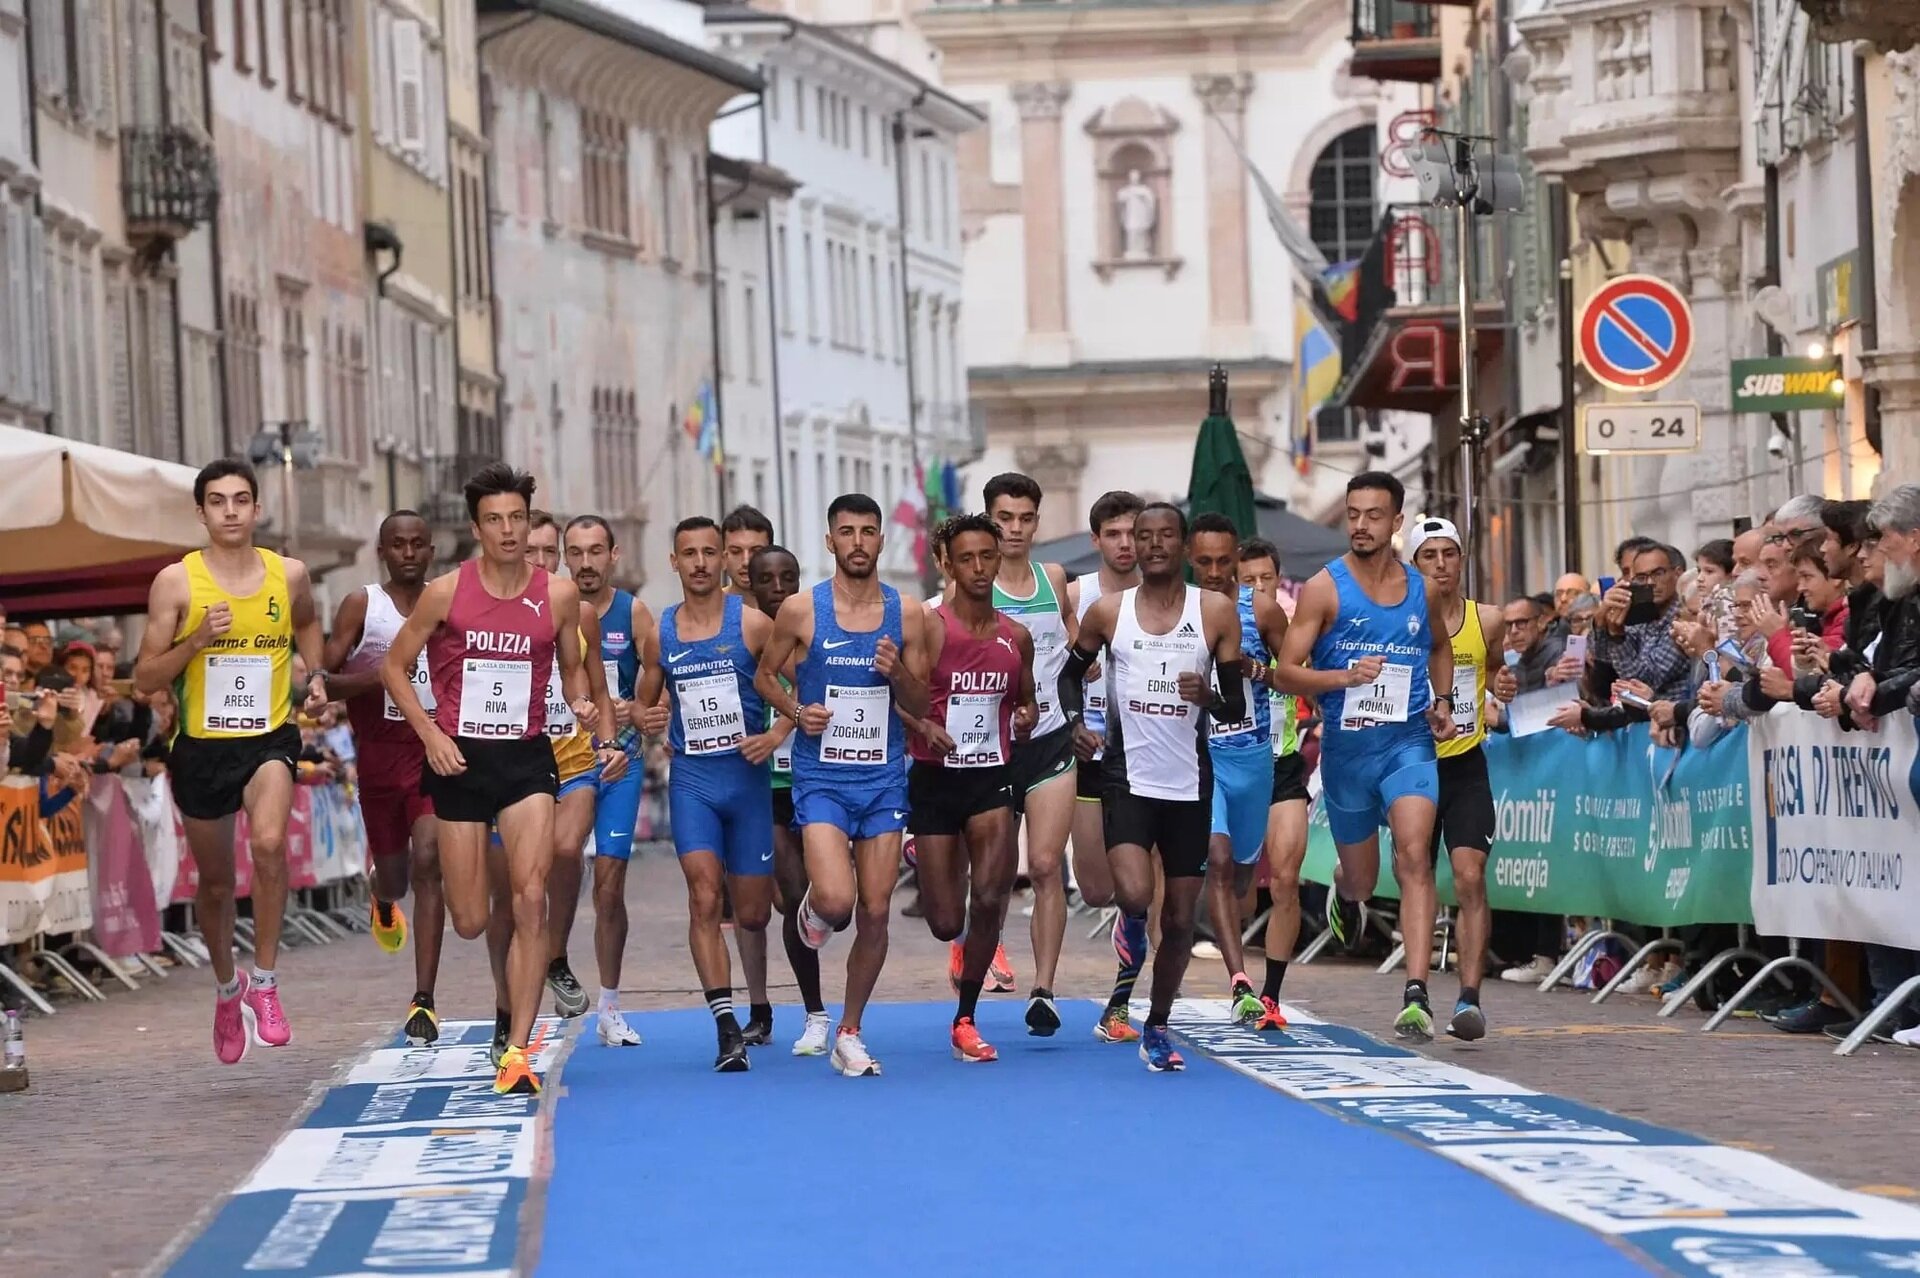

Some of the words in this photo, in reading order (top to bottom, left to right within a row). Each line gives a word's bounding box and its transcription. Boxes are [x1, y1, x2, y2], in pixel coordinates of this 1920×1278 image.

[1737, 370, 1836, 397] SUBWAY
[1599, 419, 1614, 438] 0
[1651, 418, 1684, 437] 24
[465, 631, 531, 655] POLIZIA
[672, 659, 734, 675] AERONAUTICA
[1161, 662, 1167, 675] 1
[235, 676, 245, 690] 6
[951, 672, 1008, 691] POLIZIA
[1147, 680, 1176, 693] EDRIS
[492, 682, 503, 696] 5
[1374, 684, 1386, 698] 11
[224, 695, 254, 707] ARESE
[485, 701, 507, 713] RIVA
[699, 698, 718, 712] 15
[1358, 701, 1393, 715] AOUANI
[1450, 702, 1474, 714] USSA
[688, 713, 739, 730] GERRETANA
[854, 709, 864, 723] 3
[975, 715, 984, 728] 2
[833, 726, 880, 740] ZOGHALMI
[1812, 745, 1828, 815] DI
[1832, 746, 1898, 819] TRENTO
[1496, 851, 1548, 898] energia
